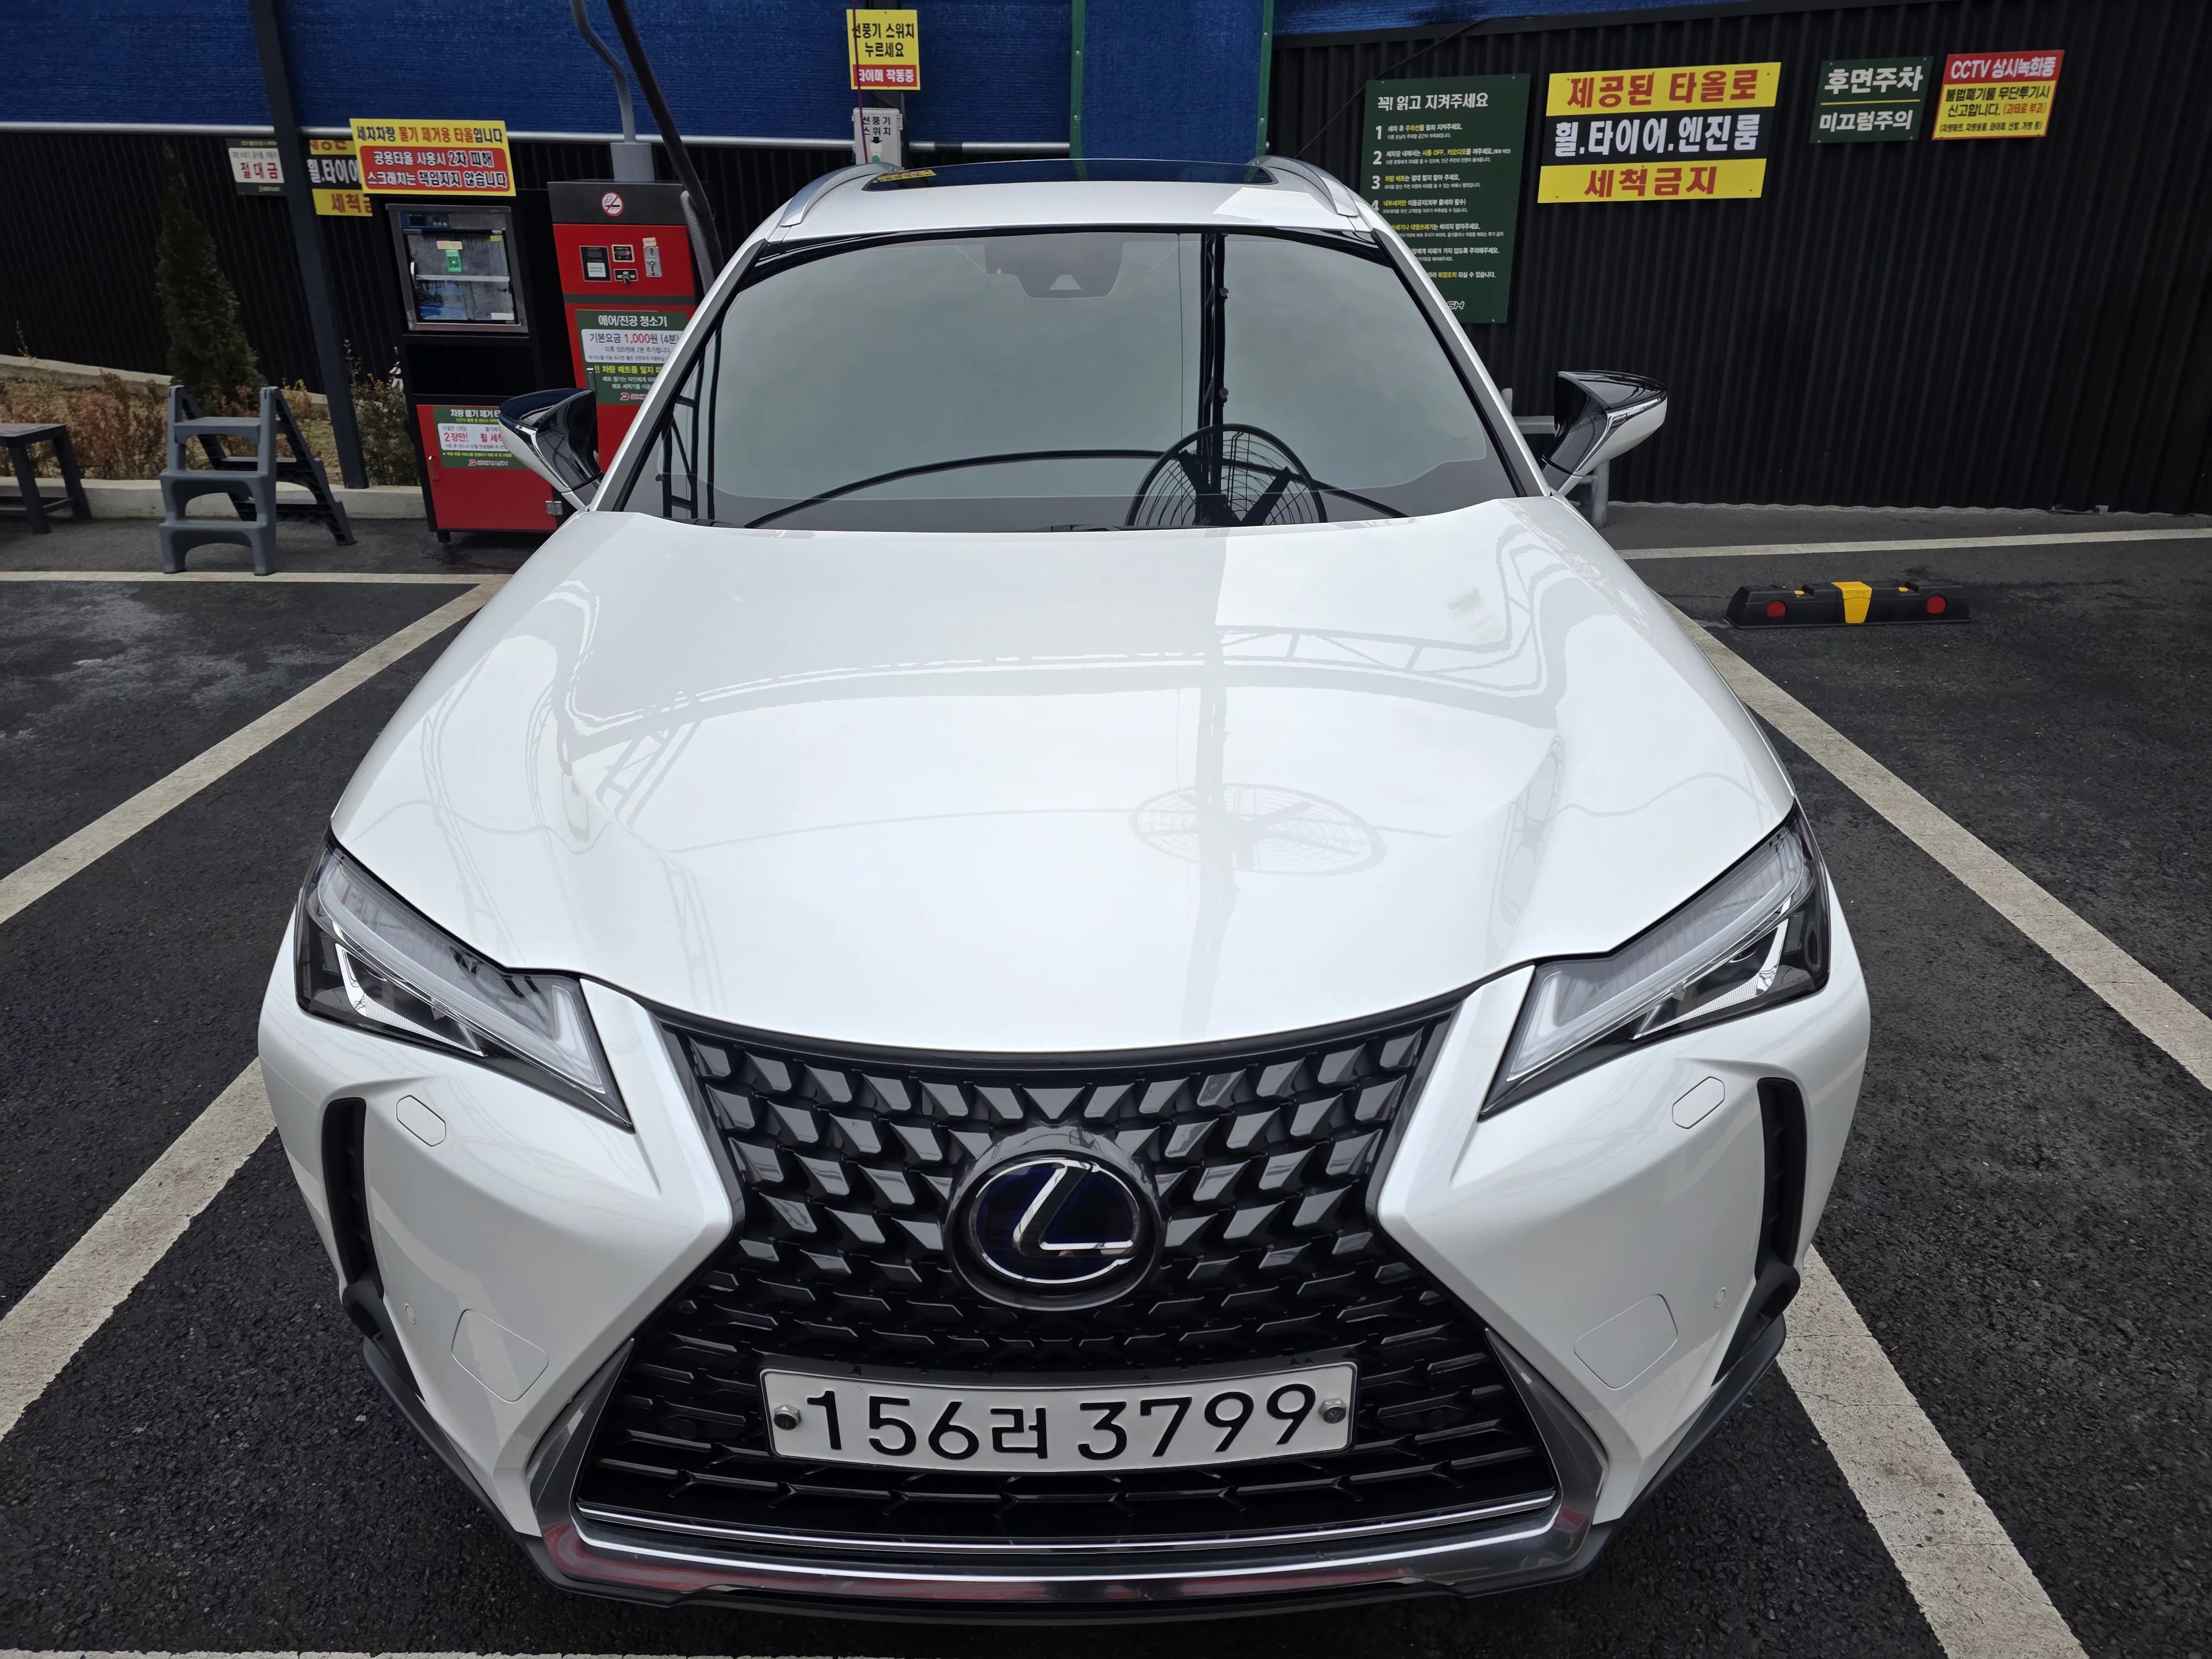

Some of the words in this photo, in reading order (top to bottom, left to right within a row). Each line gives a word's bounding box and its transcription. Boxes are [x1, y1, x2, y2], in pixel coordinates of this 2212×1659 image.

[885, 23, 915, 39] 스위치
[865, 42, 904, 58] 누르세요
[1950, 59, 1991, 79] CCTV
[1992, 56, 2057, 78] 상시녹화중
[886, 69, 914, 83] 작동중
[1824, 66, 1924, 95] 후면주차
[1567, 72, 1655, 108] 제공된
[1669, 70, 1759, 103] 타올로
[1945, 87, 1996, 102] 불법폐기물
[1999, 85, 2051, 100] 무단투기시
[1378, 97, 1394, 111] 꼭!
[1396, 96, 1421, 110] 읽고
[1425, 92, 1488, 109] 지켜주세요
[1948, 103, 2001, 117] 신고합니다.
[1819, 109, 1913, 132] 미끄럼주의
[357, 126, 396, 142] 세차차량
[399, 127, 419, 142] 물기
[420, 127, 451, 143] 제거용
[453, 127, 503, 143] 타올입니다
[863, 127, 891, 136] 스위치
[1375, 126, 1382, 140] 1
[1554, 114, 1760, 157] 휠.타이어.엔진룸
[373, 150, 414, 166] 공용타올
[416, 151, 446, 166] 사용시
[447, 150, 468, 166] 2차
[469, 150, 494, 167] 피해
[1373, 150, 1383, 165] 2
[367, 171, 416, 186] 스크래치는
[418, 170, 462, 187] 책임지지
[464, 170, 508, 188] 않습니다
[1371, 175, 1381, 190] 3
[1584, 166, 1717, 197] 세척금지
[1371, 200, 1380, 211] 4
[598, 315, 638, 327] 에어/진공
[640, 316, 667, 327] 청소기
[589, 333, 621, 343] 기본요금
[624, 333, 658, 345] 1,000원
[602, 365, 615, 374] 차량
[618, 366, 638, 374] 매트를
[640, 366, 654, 374] 털지
[806, 1390, 1048, 1460] 156러
[1077, 1384, 1316, 1460] 3799
